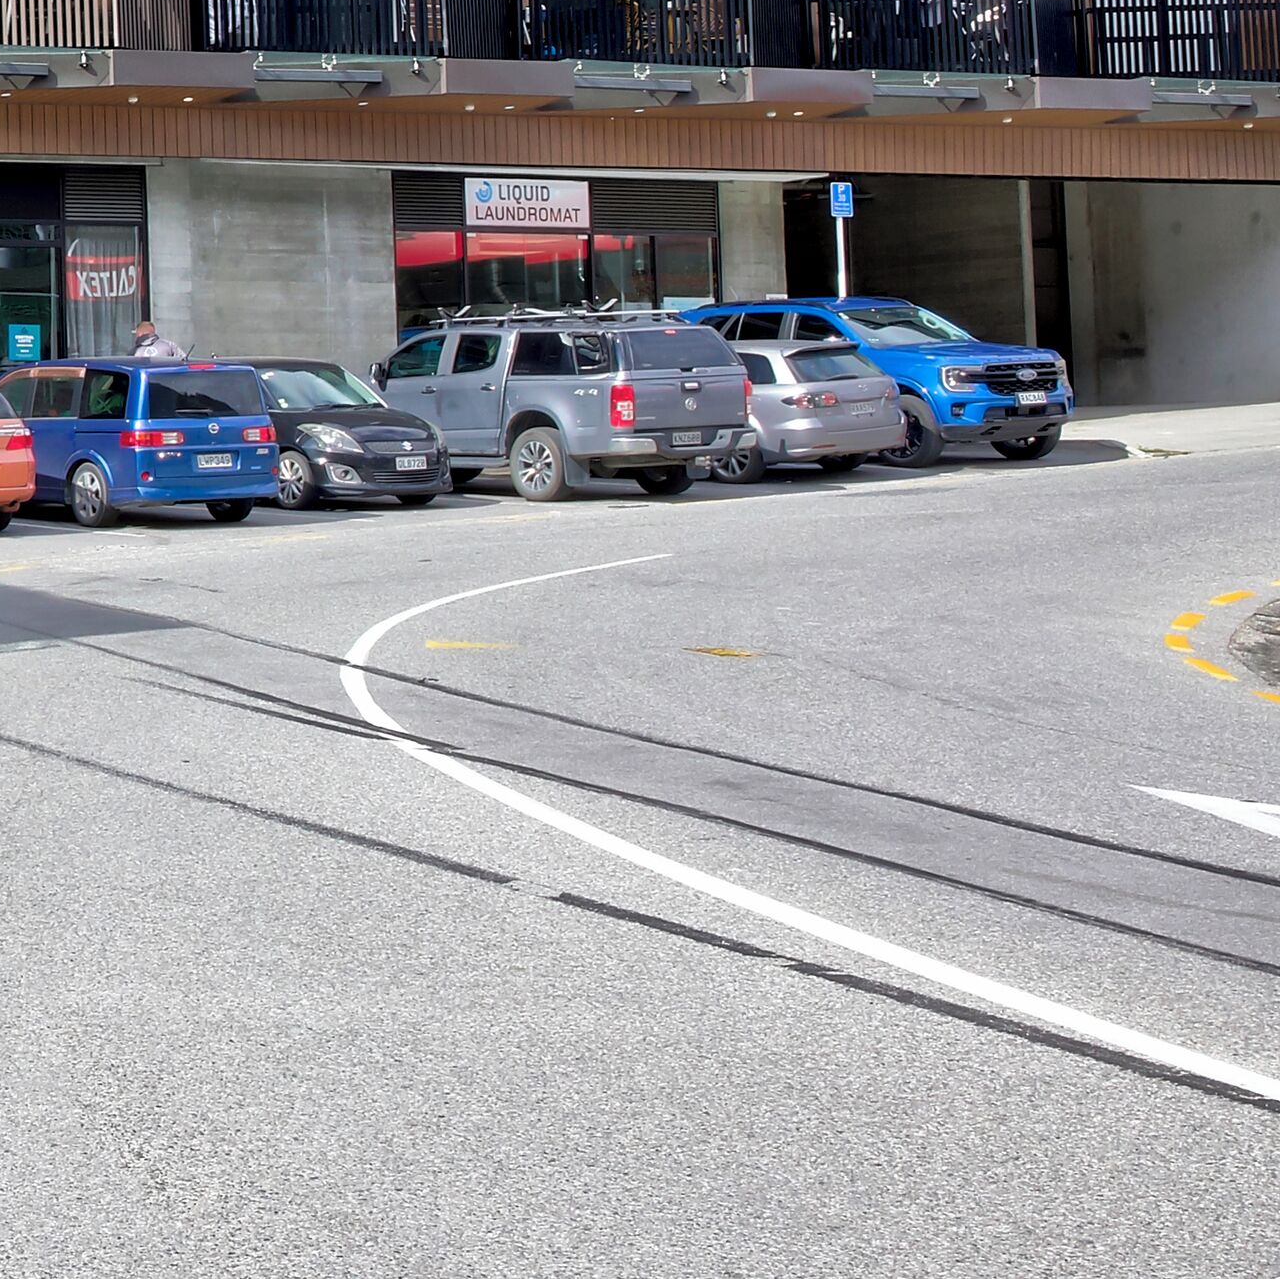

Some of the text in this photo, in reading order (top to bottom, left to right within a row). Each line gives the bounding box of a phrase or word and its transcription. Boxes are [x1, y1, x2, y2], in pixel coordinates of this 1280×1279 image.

[498, 184, 550, 204] LIQUID
[475, 205, 581, 223] LAUNDROMAT
[198, 455, 231, 467] LWP349
